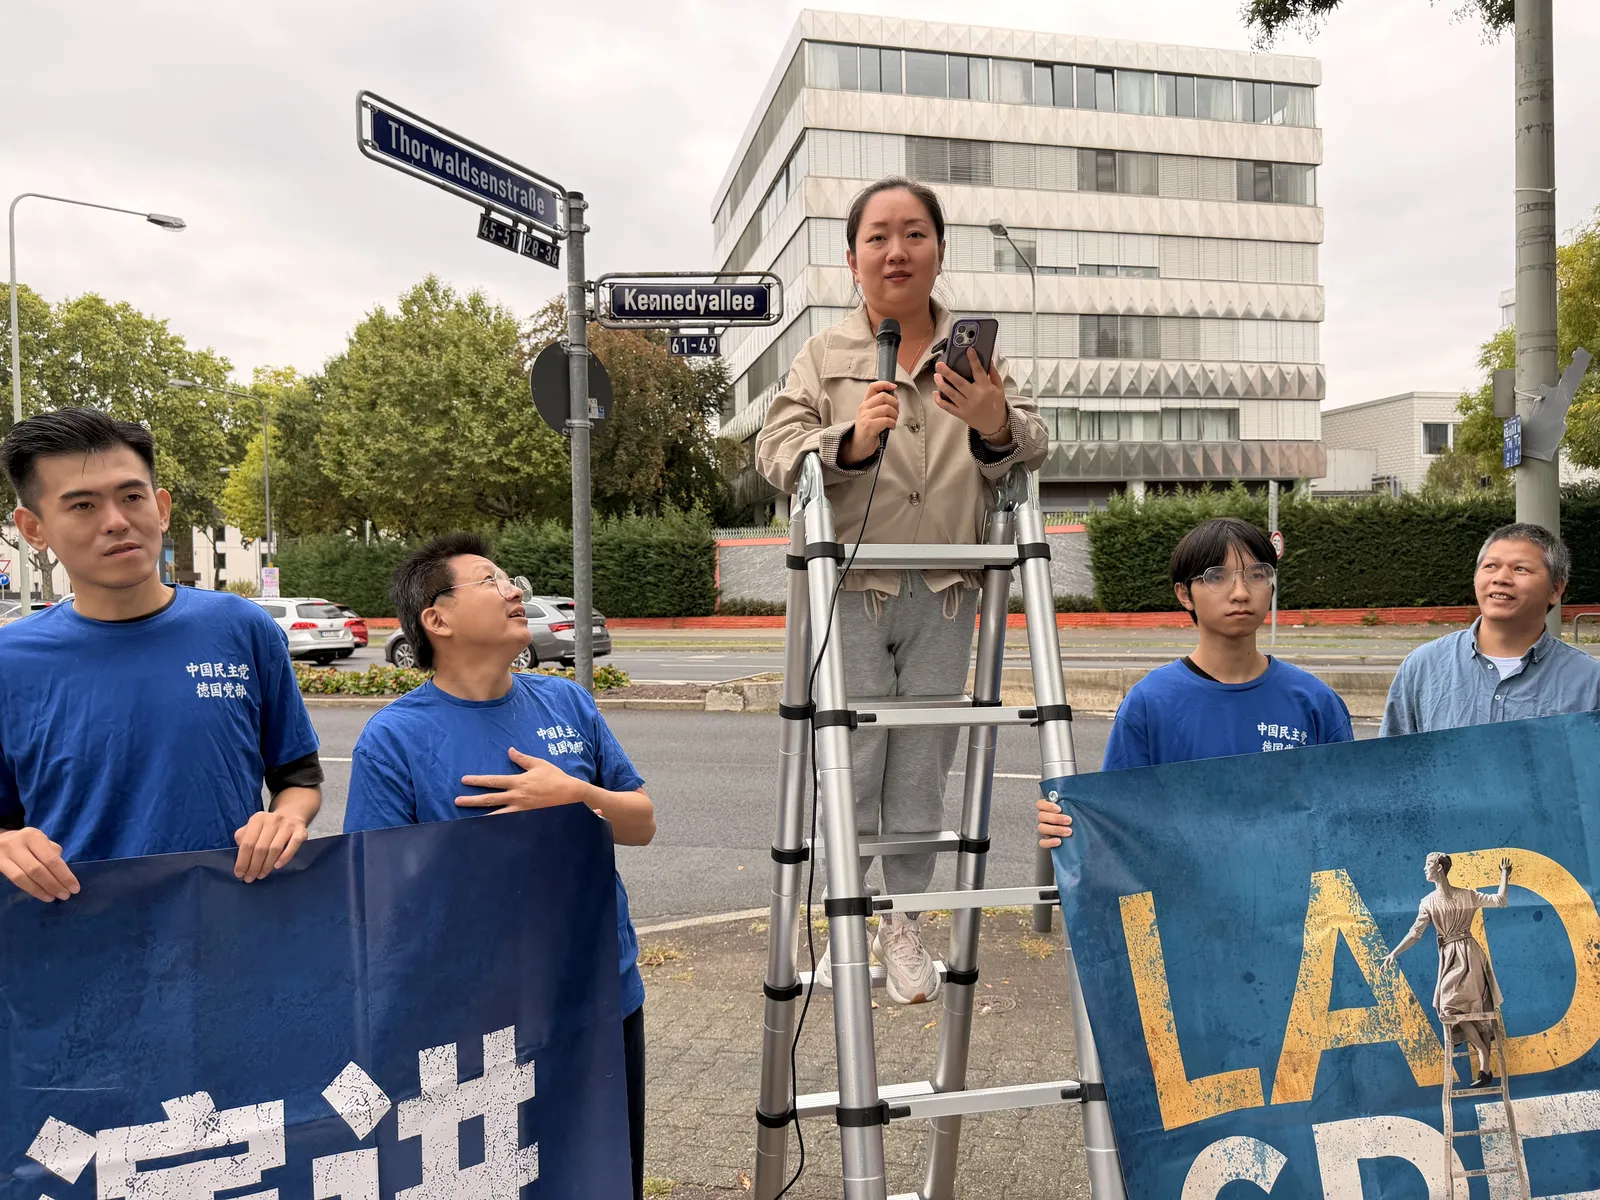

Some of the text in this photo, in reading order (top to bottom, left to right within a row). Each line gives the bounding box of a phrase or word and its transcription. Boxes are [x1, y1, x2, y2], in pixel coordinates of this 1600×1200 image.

[388, 120, 545, 215] Thorwaldsenstraße
[481, 219, 518, 248] 45-51
[525, 236, 558, 264] 28-36
[624, 288, 755, 315] Kennedyallee
[671, 337, 717, 354] 61-49
[186, 662, 250, 680] 中国民主党
[196, 681, 247, 699] 德国党部
[536, 725, 580, 741] 中国民主
[1257, 721, 1308, 745] 中国民主党
[1261, 740, 1299, 753] 德国
[1118, 847, 1600, 1131] LAD
